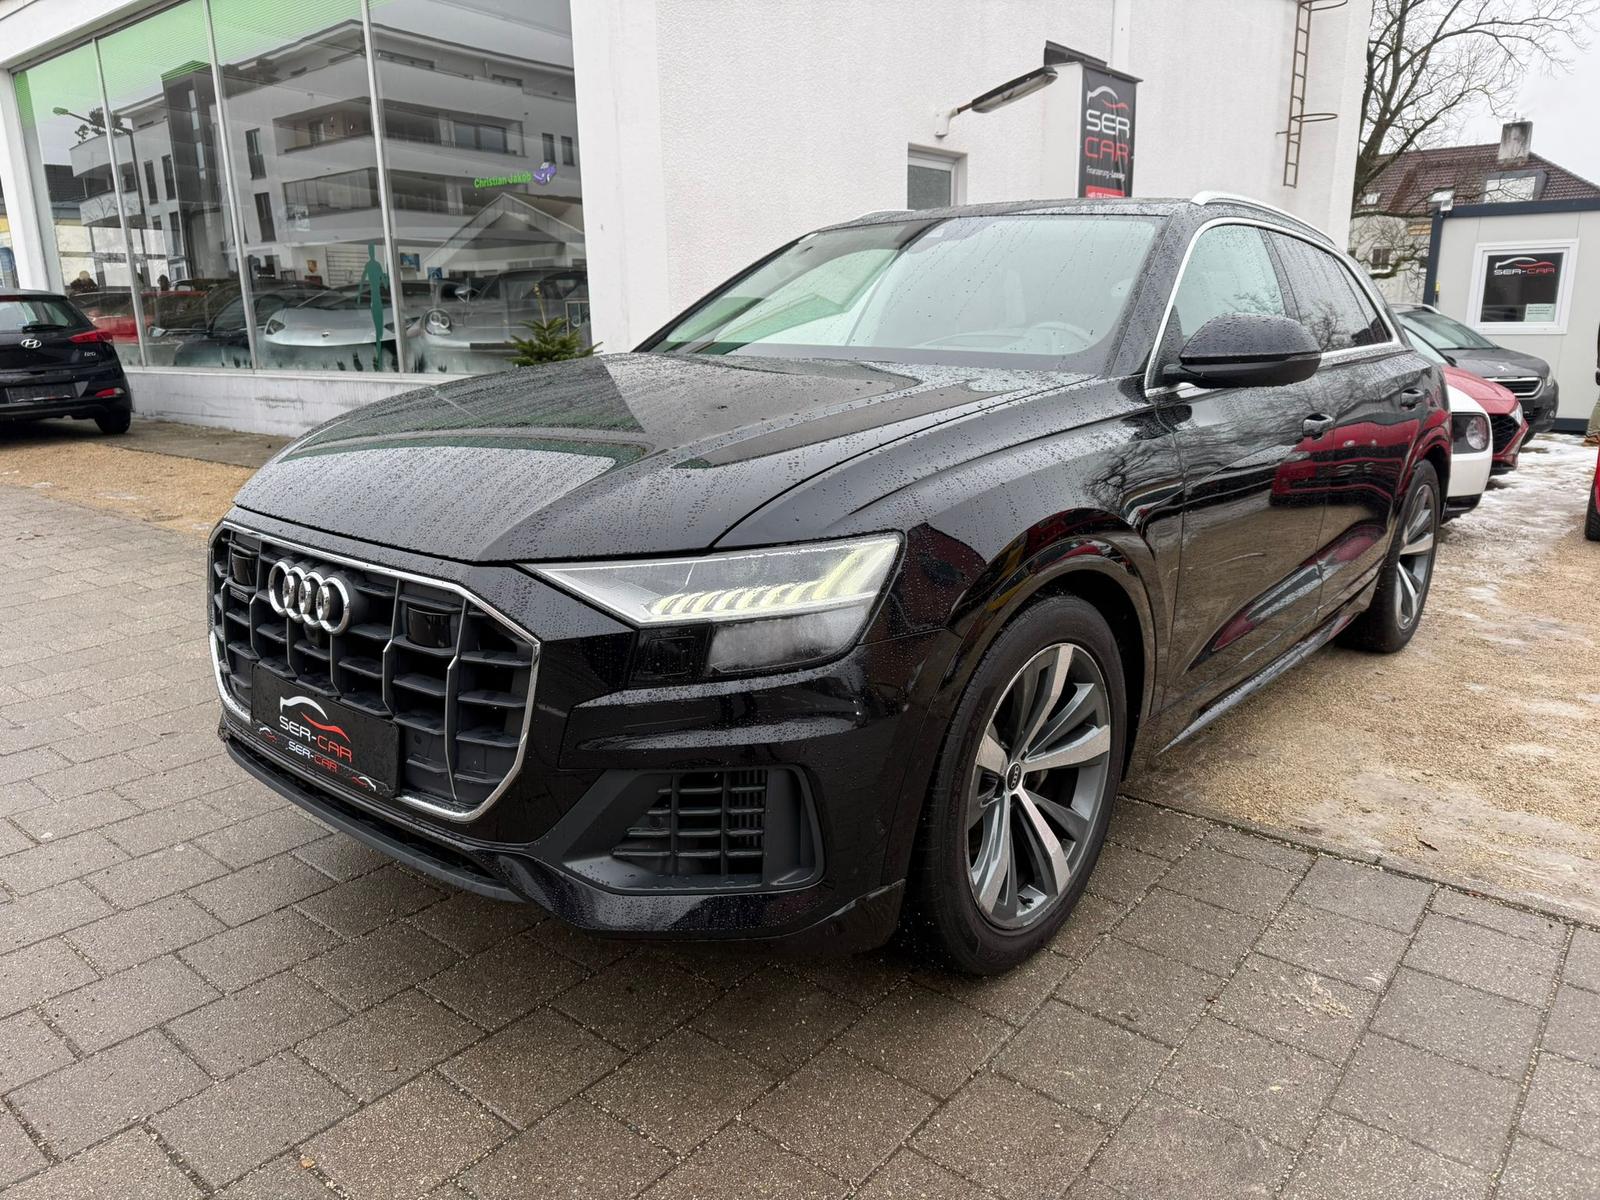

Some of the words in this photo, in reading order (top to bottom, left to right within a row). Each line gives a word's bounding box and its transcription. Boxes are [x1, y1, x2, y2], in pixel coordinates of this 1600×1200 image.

[1086, 109, 1130, 139] SER
[1085, 136, 1129, 165] CAR
[473, 175, 507, 189] Christian
[508, 170, 532, 184] Jakob
[1494, 267, 1555, 276] SER-CAR
[279, 715, 352, 764] SER-CAR
[287, 741, 338, 773] SER-CAR
